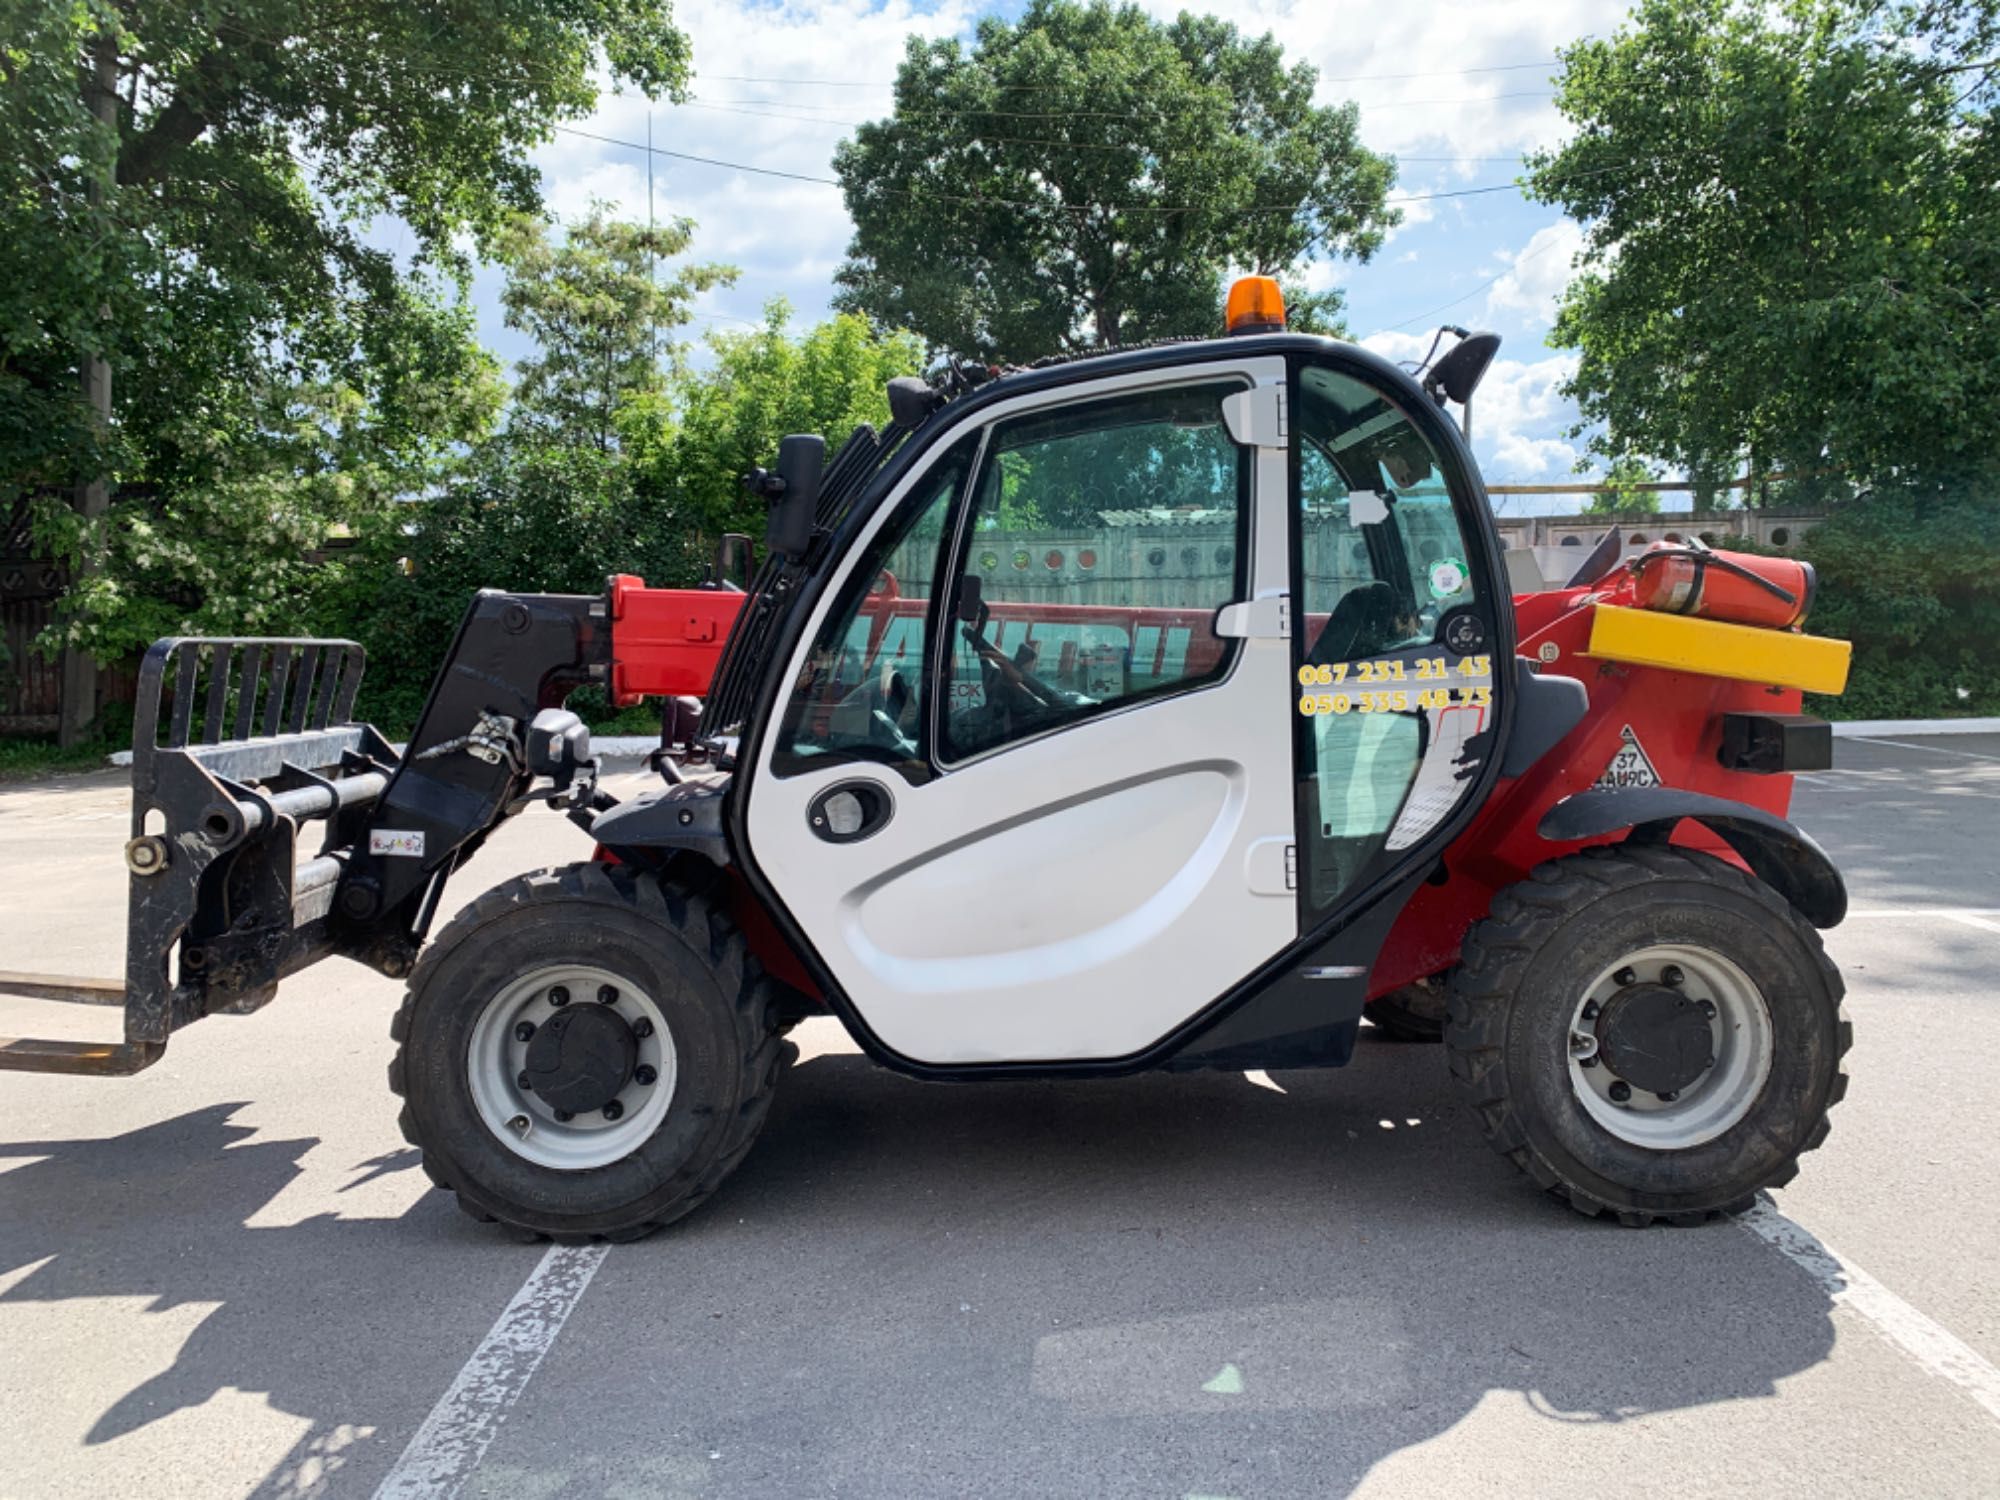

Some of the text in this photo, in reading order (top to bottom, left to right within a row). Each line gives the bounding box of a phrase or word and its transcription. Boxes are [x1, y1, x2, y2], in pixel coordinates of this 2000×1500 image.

[1298, 657, 1491, 685] 067 231 21 43
[1299, 688, 1491, 715] 050 335 48 73
[1617, 753, 1637, 769] 37
